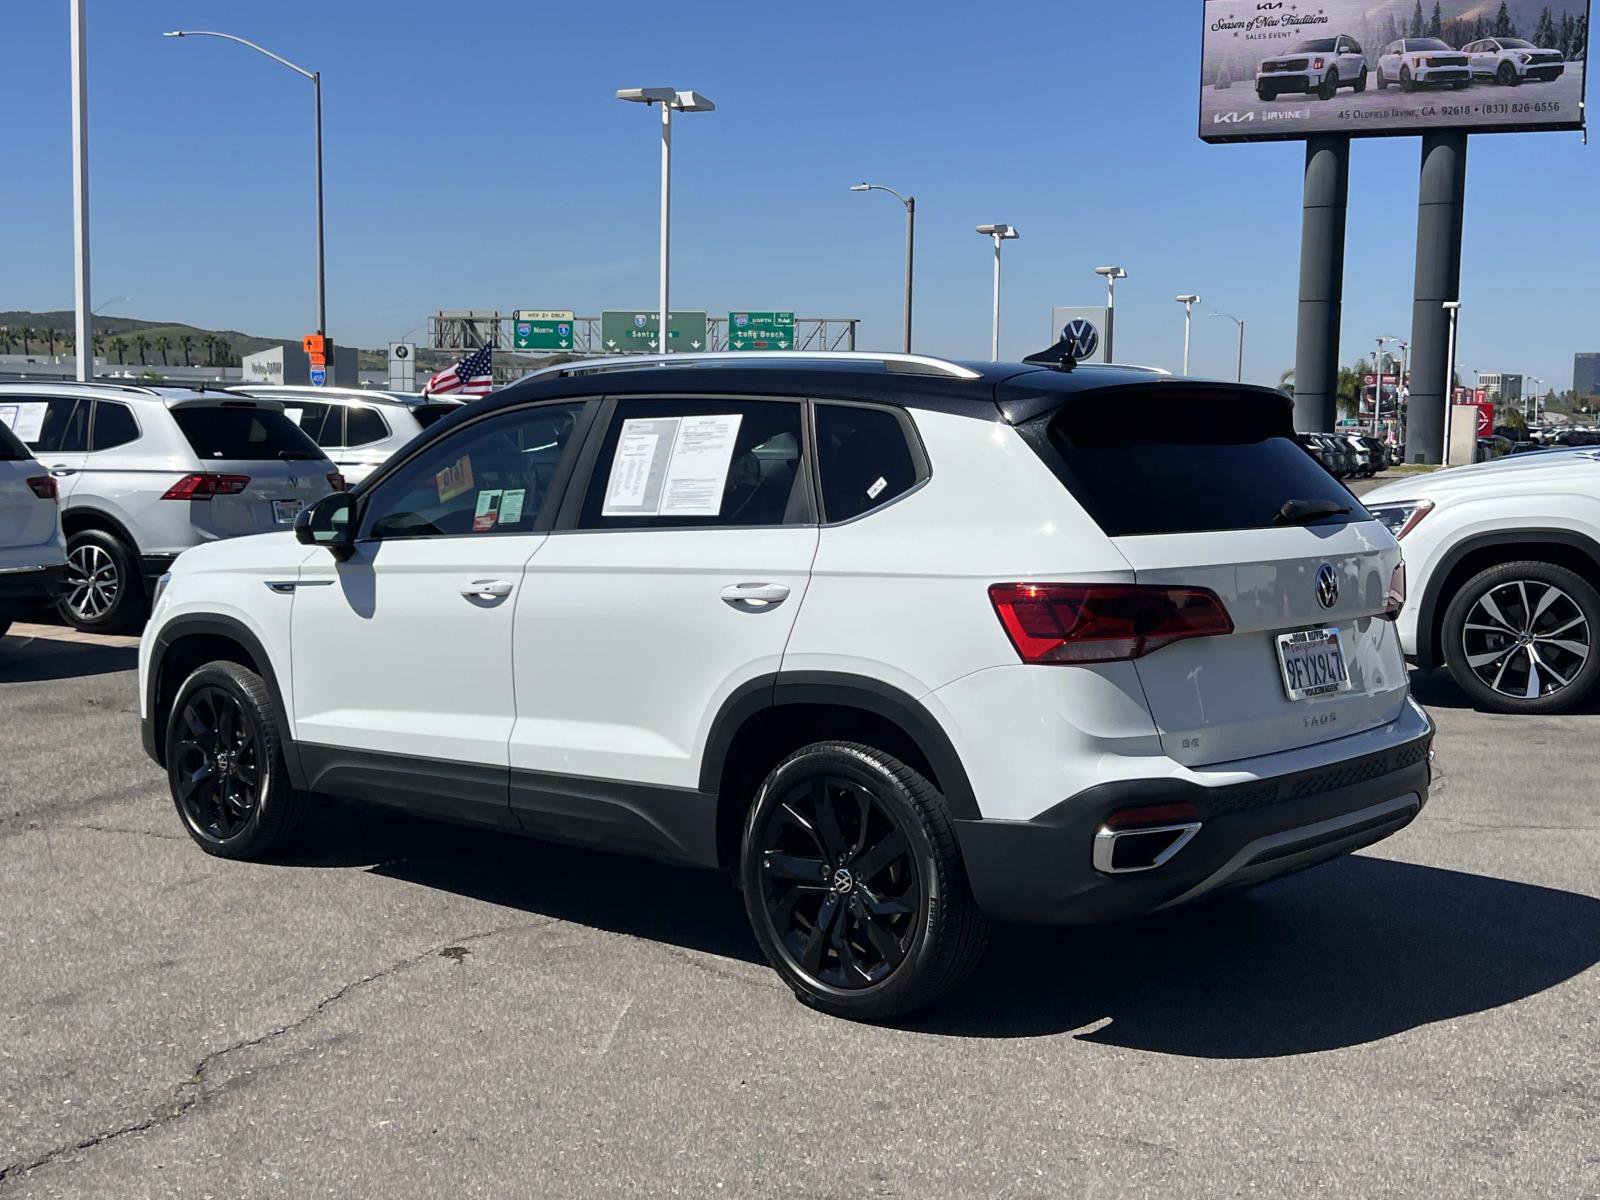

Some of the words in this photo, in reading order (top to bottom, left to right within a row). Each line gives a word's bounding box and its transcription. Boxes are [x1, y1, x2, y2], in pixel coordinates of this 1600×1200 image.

[1211, 18, 1245, 31] Season
[1246, 17, 1256, 31] of
[1256, 15, 1280, 28] New
[1281, 13, 1328, 27] Traditions
[1268, 31, 1291, 39] EVENT
[1267, 110, 1302, 121] IRVINE
[1338, 110, 1350, 120] 45
[1441, 105, 1471, 116] 92618
[1482, 103, 1508, 115] (833)
[1511, 101, 1560, 114] 826-6556
[632, 330, 654, 338] Santa
[1286, 651, 1348, 690] 9FYX947
[1303, 711, 1337, 729] TAOS
